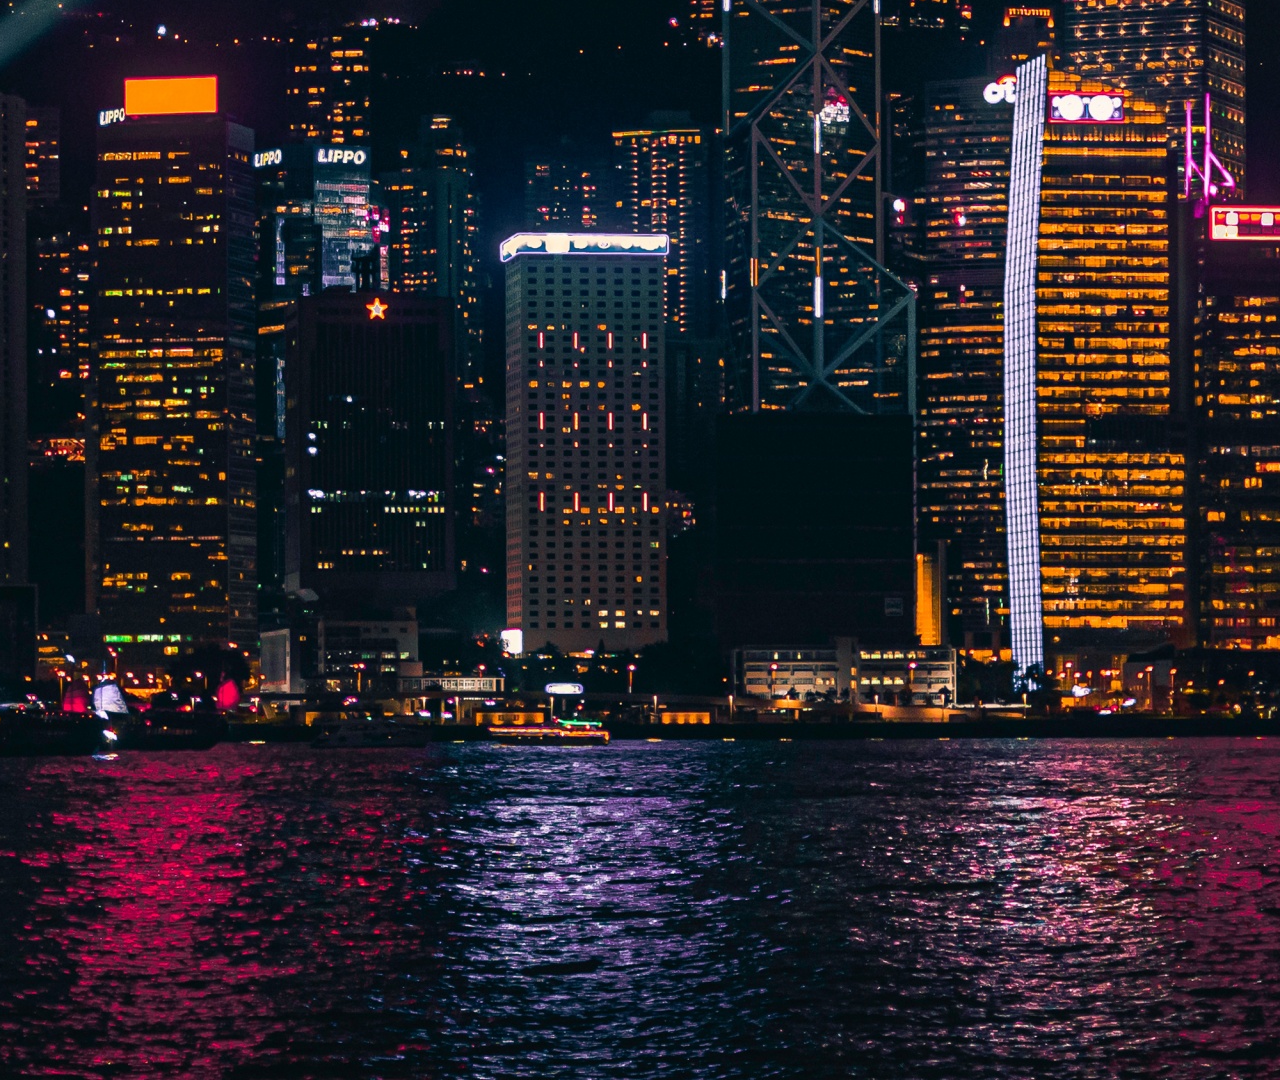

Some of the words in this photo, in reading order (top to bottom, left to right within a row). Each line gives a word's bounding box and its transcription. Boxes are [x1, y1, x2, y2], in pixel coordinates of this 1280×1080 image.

[100, 108, 125, 125] LIPPO
[254, 144, 282, 168] LIPPO
[317, 148, 366, 165] LIPPO
